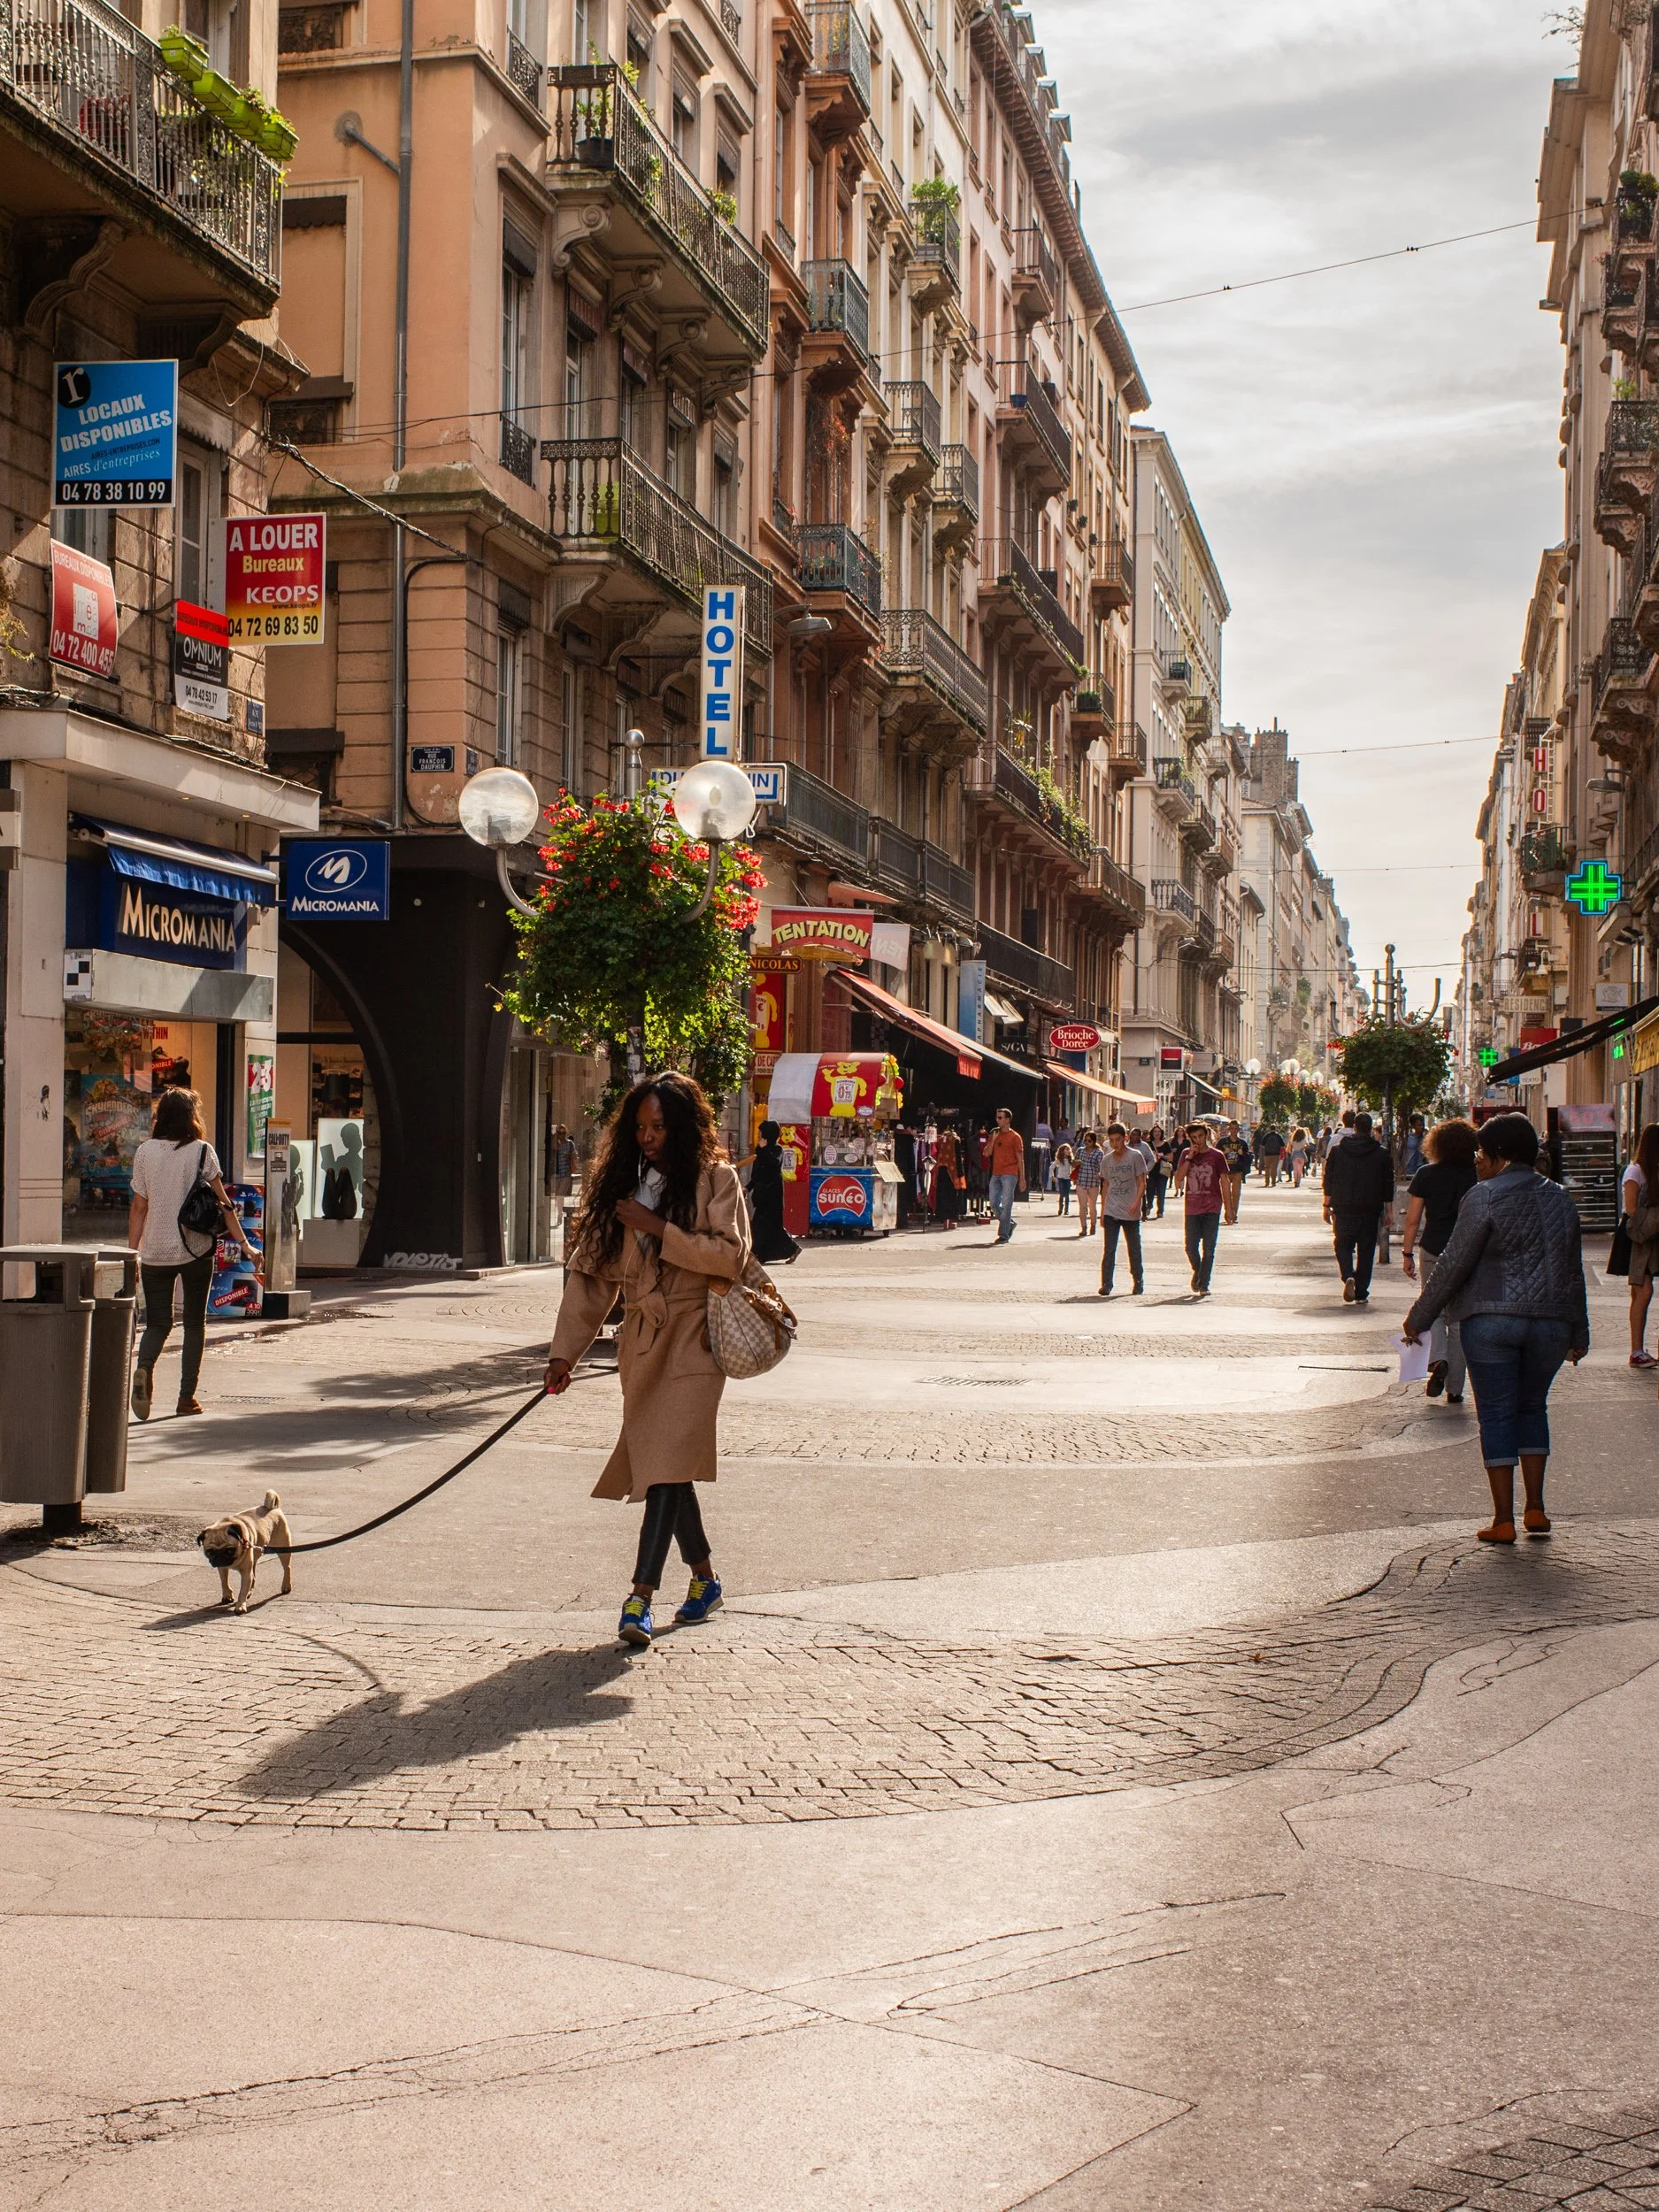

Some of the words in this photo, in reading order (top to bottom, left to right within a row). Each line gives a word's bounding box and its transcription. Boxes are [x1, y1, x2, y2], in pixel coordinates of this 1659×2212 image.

[78, 394, 145, 425] LOCAUX
[60, 410, 173, 452] DISPONIBLES
[91, 438, 160, 459] AIRES-ENTREPRISES.COM
[64, 462, 91, 479] AIRES
[94, 449, 160, 472] d'entreprises
[62, 483, 80, 501] 04
[84, 483, 101, 501] 78
[105, 482, 122, 501] 38
[127, 482, 144, 500] 10
[148, 481, 165, 500] 99
[229, 526, 243, 552] A
[250, 523, 319, 551] LOUER
[54, 549, 80, 573] BUREAUX
[242, 555, 304, 573] Bureaux
[246, 585, 319, 604] KEOPS
[228, 618, 242, 637] 04
[247, 617, 261, 637] 72
[265, 617, 280, 636] 69
[284, 616, 299, 635] 83
[303, 615, 319, 635] 50
[53, 629, 65, 655] 04
[68, 634, 80, 660] 72
[81, 640, 97, 666] 400
[98, 646, 115, 673] 455
[183, 636, 221, 667] OMNIUM
[706, 592, 734, 755] HOTEL
[772, 920, 870, 948] TENTATION
[749, 960, 798, 970] NICOLAS
[1057, 1029, 1094, 1040] Brioche
[97, 1116, 132, 1136] DISPONIBLE
[214, 1286, 249, 1307] DISPONIBLE
